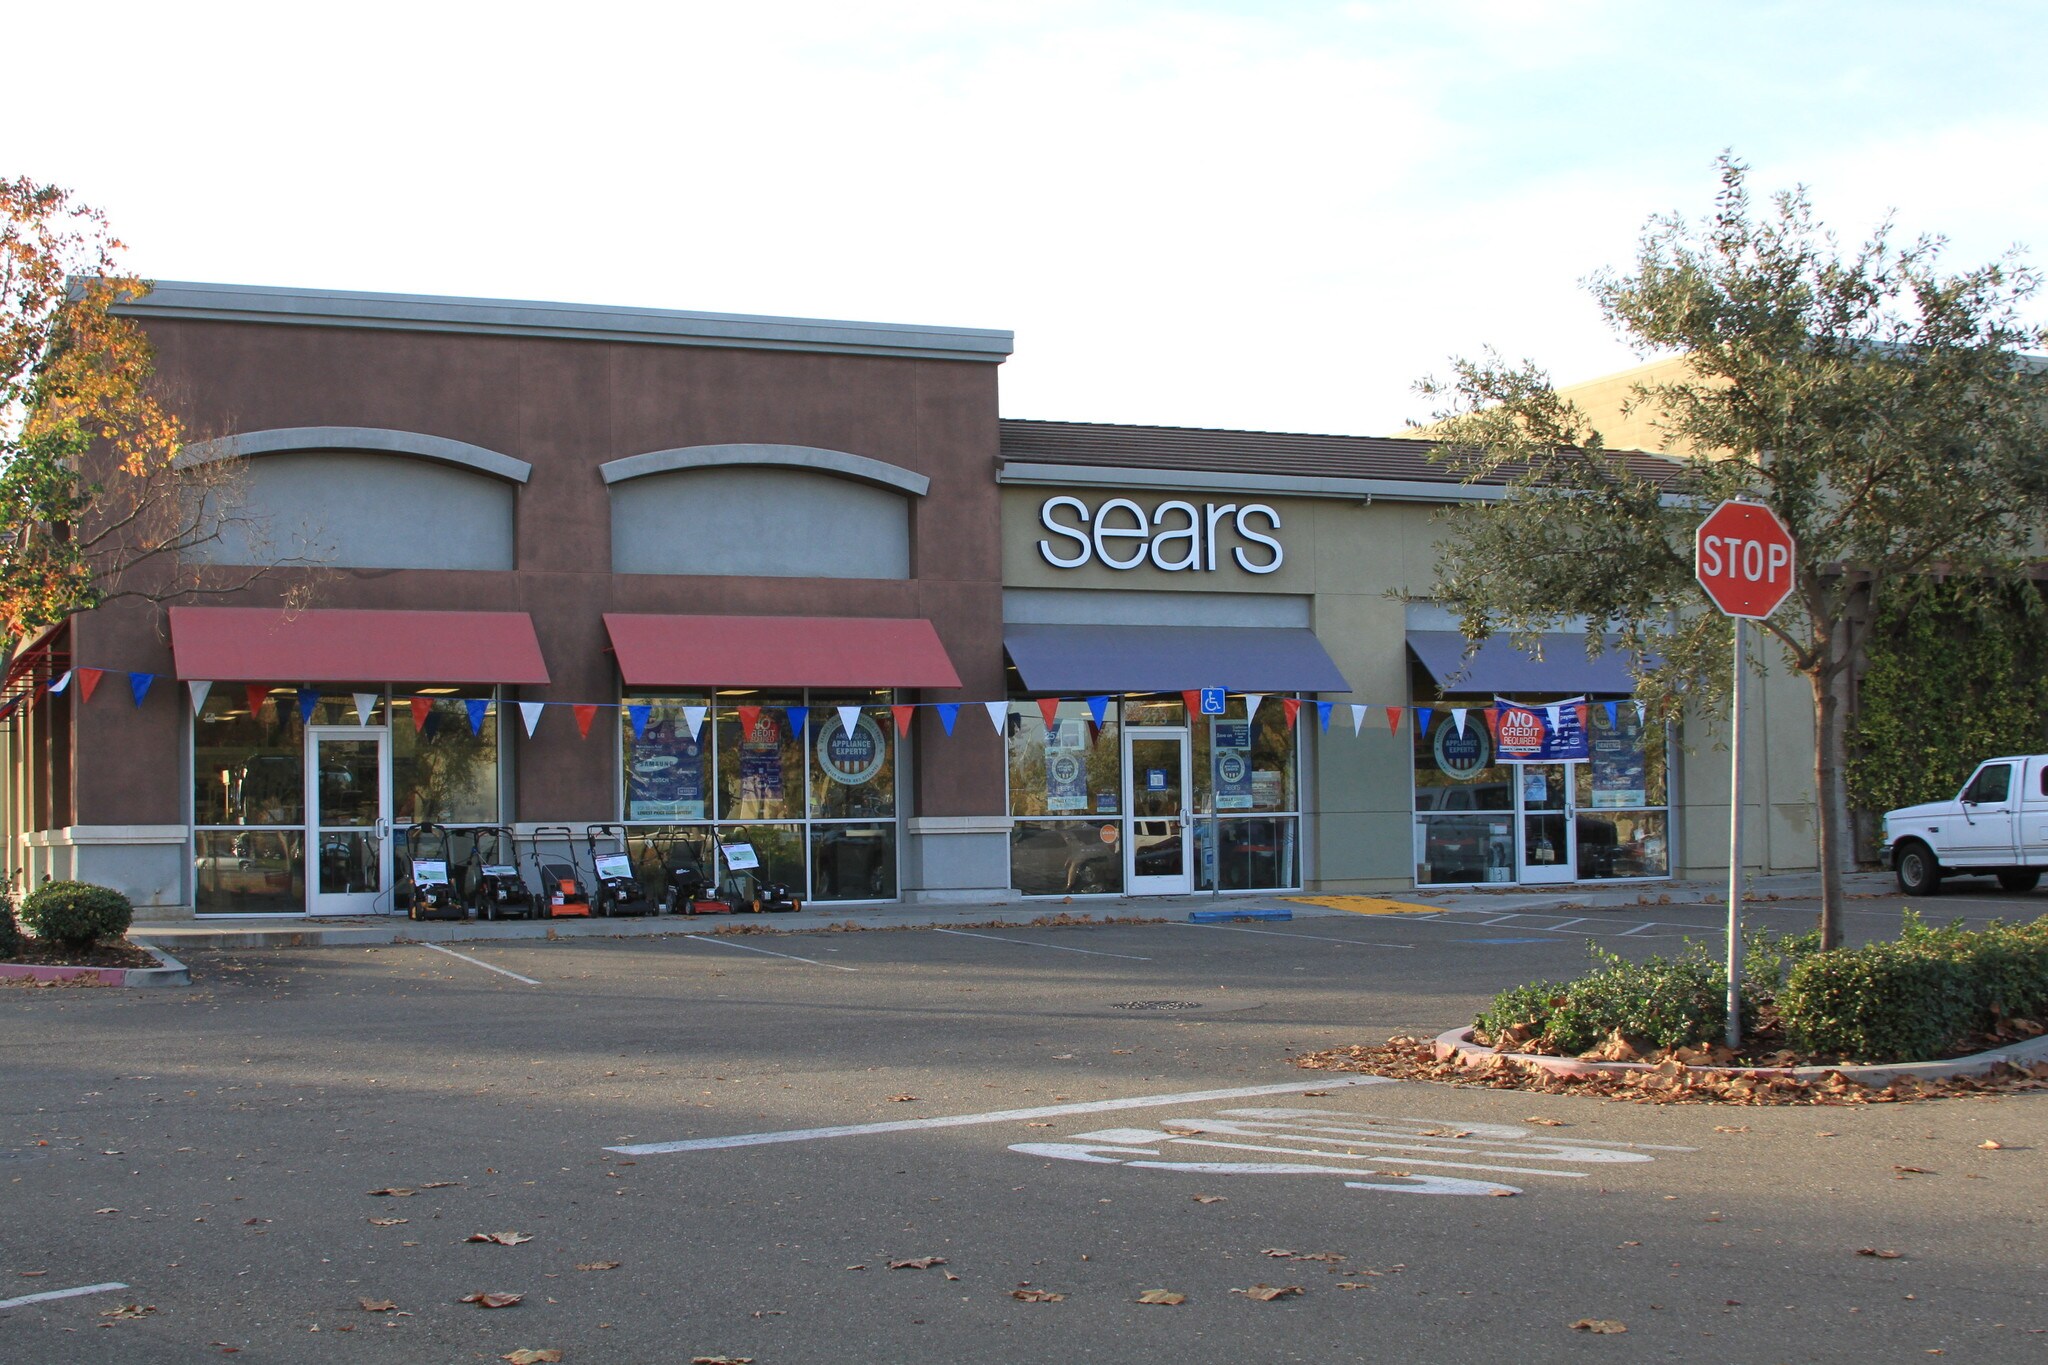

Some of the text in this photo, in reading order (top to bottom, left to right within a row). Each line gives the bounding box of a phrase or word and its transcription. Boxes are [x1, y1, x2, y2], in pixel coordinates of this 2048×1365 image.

[1038, 495, 1284, 574] sears
[1703, 535, 1788, 583] STOP
[1507, 711, 1533, 728] NO
[752, 729, 776, 737] REDIT
[1501, 727, 1539, 736] CREDIT
[832, 740, 871, 748] APPLIANCE
[1503, 736, 1536, 745] REQUIRED
